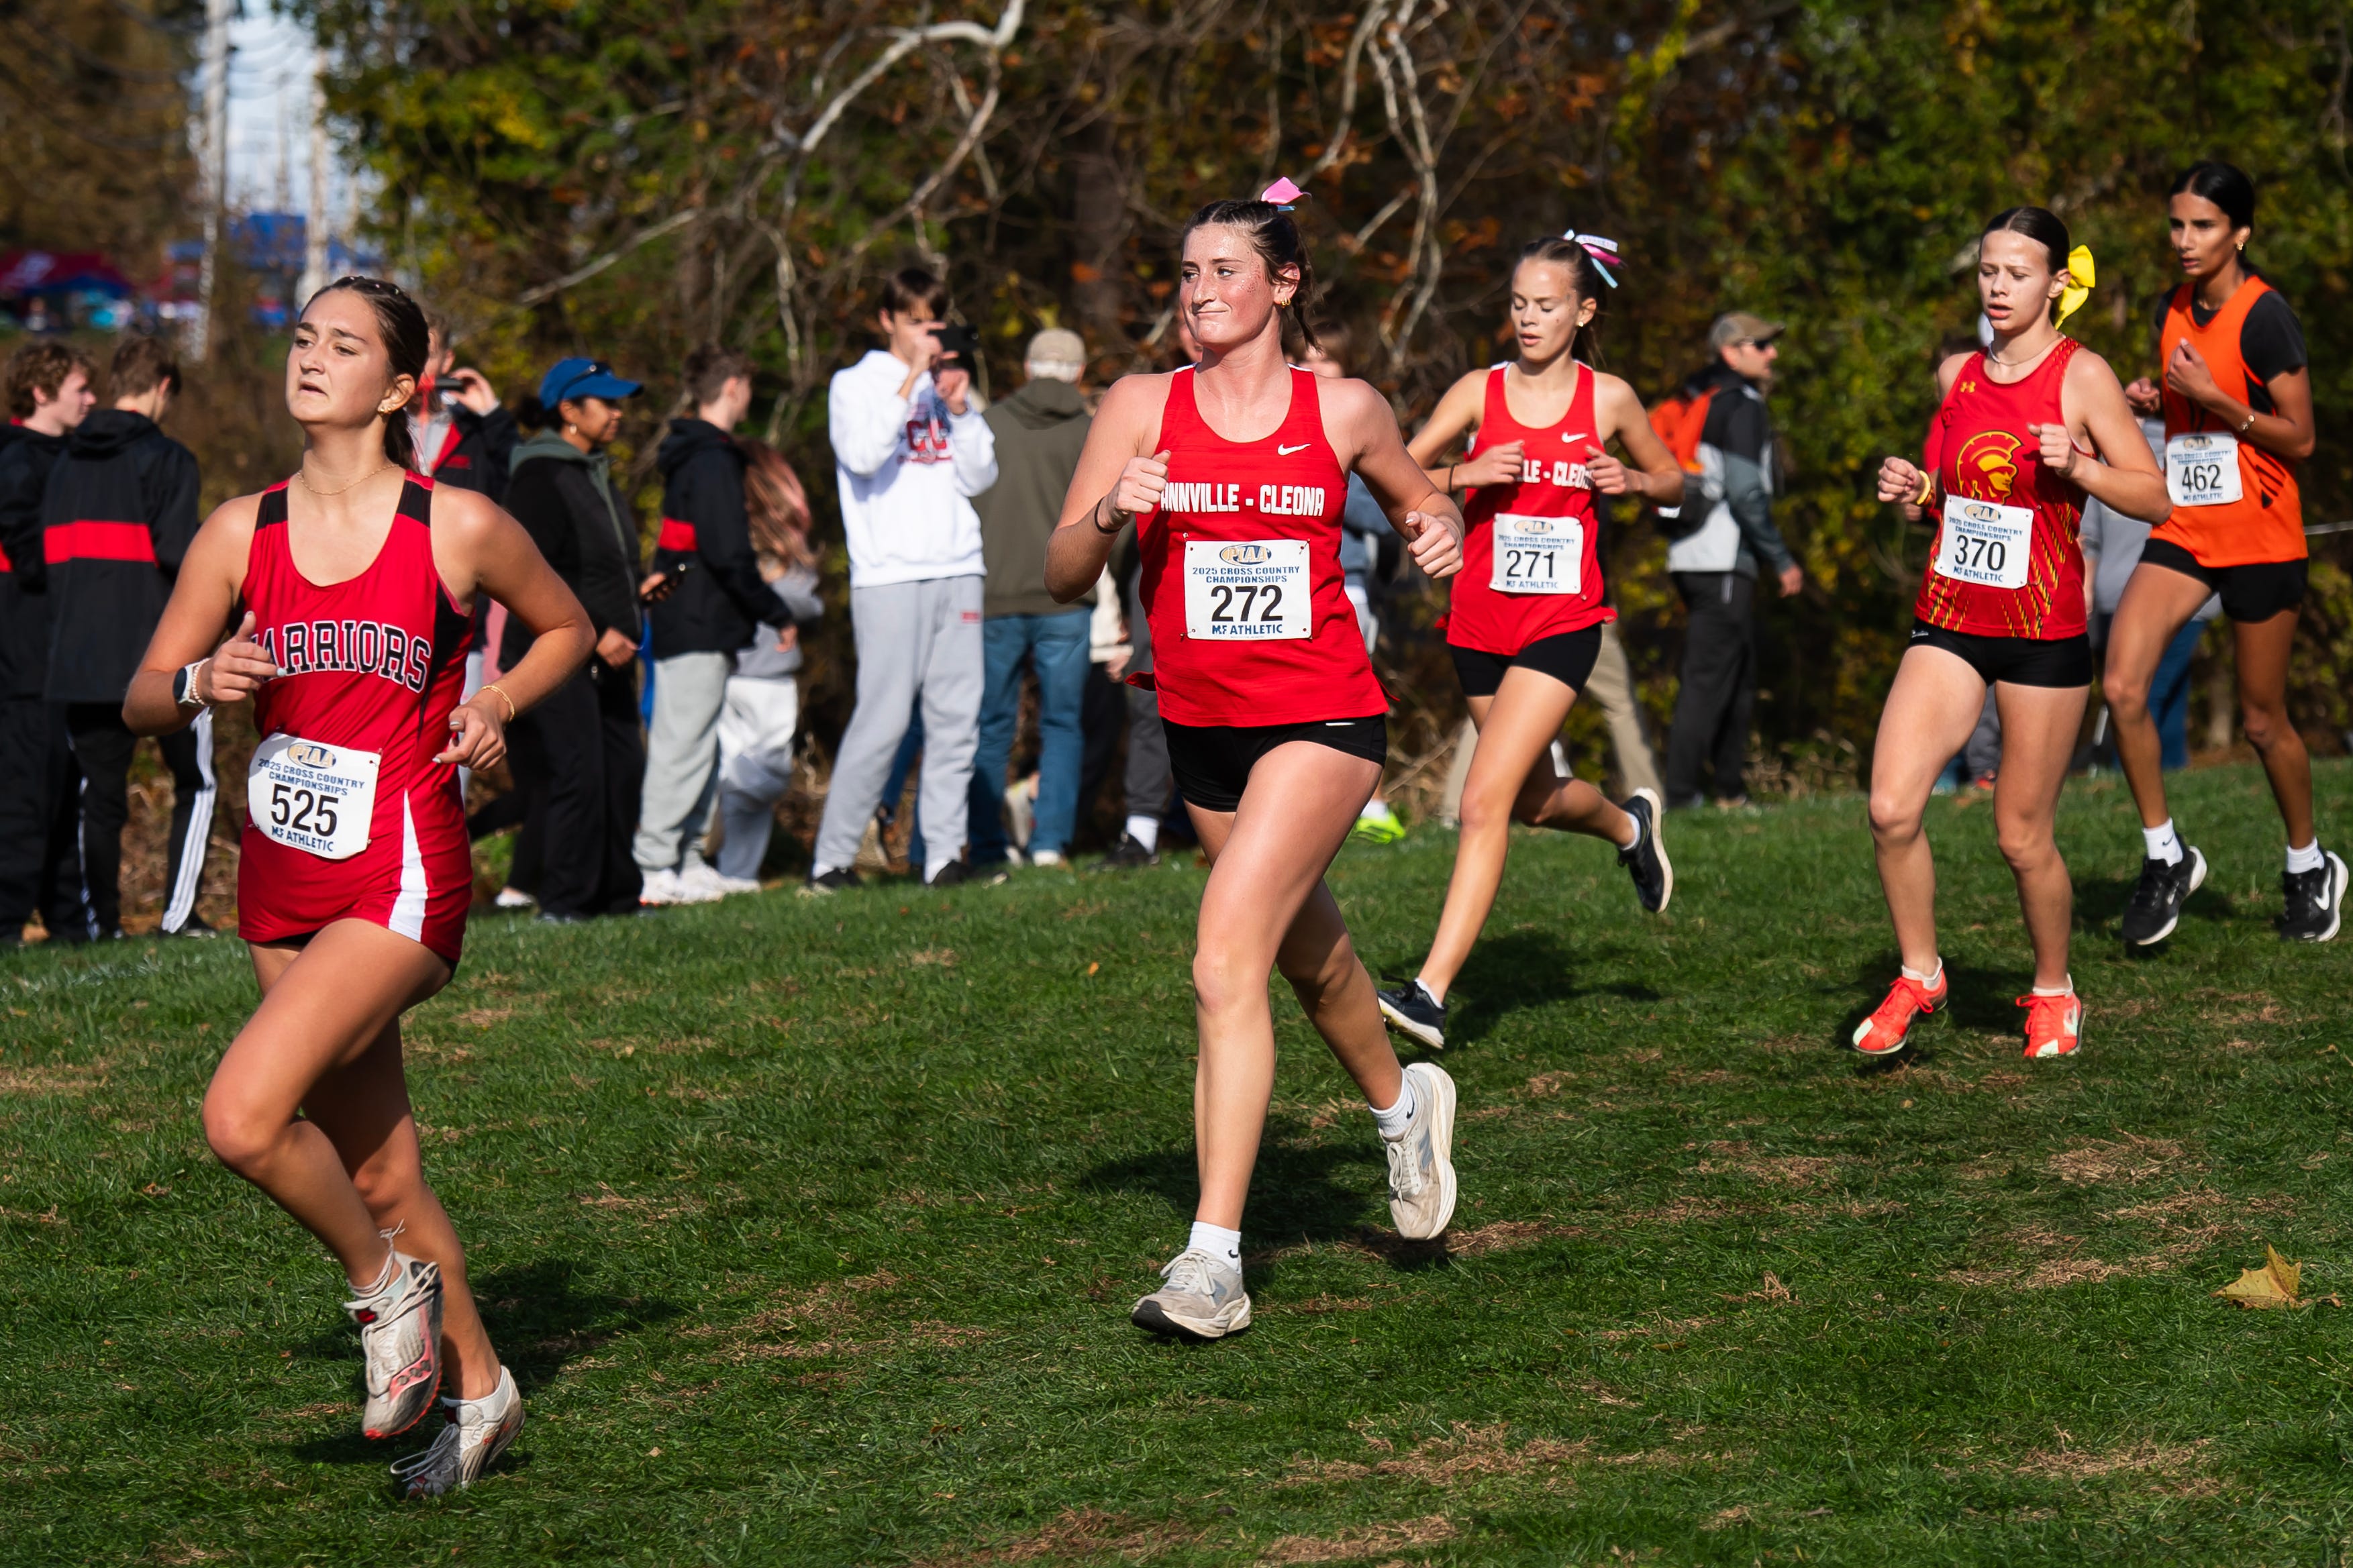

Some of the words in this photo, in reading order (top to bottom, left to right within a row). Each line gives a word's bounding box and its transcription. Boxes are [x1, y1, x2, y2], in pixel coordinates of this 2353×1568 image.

[2182, 464, 2223, 492] 462
[1259, 484, 1325, 516] CLEONA
[1955, 526, 2011, 541] CHAMPIONSHIPS
[1963, 521, 1985, 530] CROSS
[1988, 524, 2023, 536] COUNTRY
[1227, 546, 1268, 564] PIAA
[1506, 550, 1554, 578] 271
[1954, 535, 2005, 571] 370
[1193, 567, 1217, 575] 2025
[1220, 567, 1252, 575] CROSS
[1255, 566, 1300, 575] COUNTRY
[1206, 575, 1287, 584] CHAMPIONSHIPS
[1964, 570, 2003, 582] ATHLETIC
[1519, 580, 1558, 588] ATHLETIC
[1211, 584, 1283, 622] 272
[1230, 624, 1283, 635] ATHLETIC
[251, 619, 432, 693] ARRIORS
[291, 744, 335, 768] PIAA
[258, 758, 281, 771] 2025
[283, 765, 314, 779] CROSS
[317, 773, 365, 788] COUNTRY
[269, 772, 348, 796] CHAMPIONSHIPS
[270, 783, 339, 837] 525
[287, 830, 334, 851] ATHLETIC
